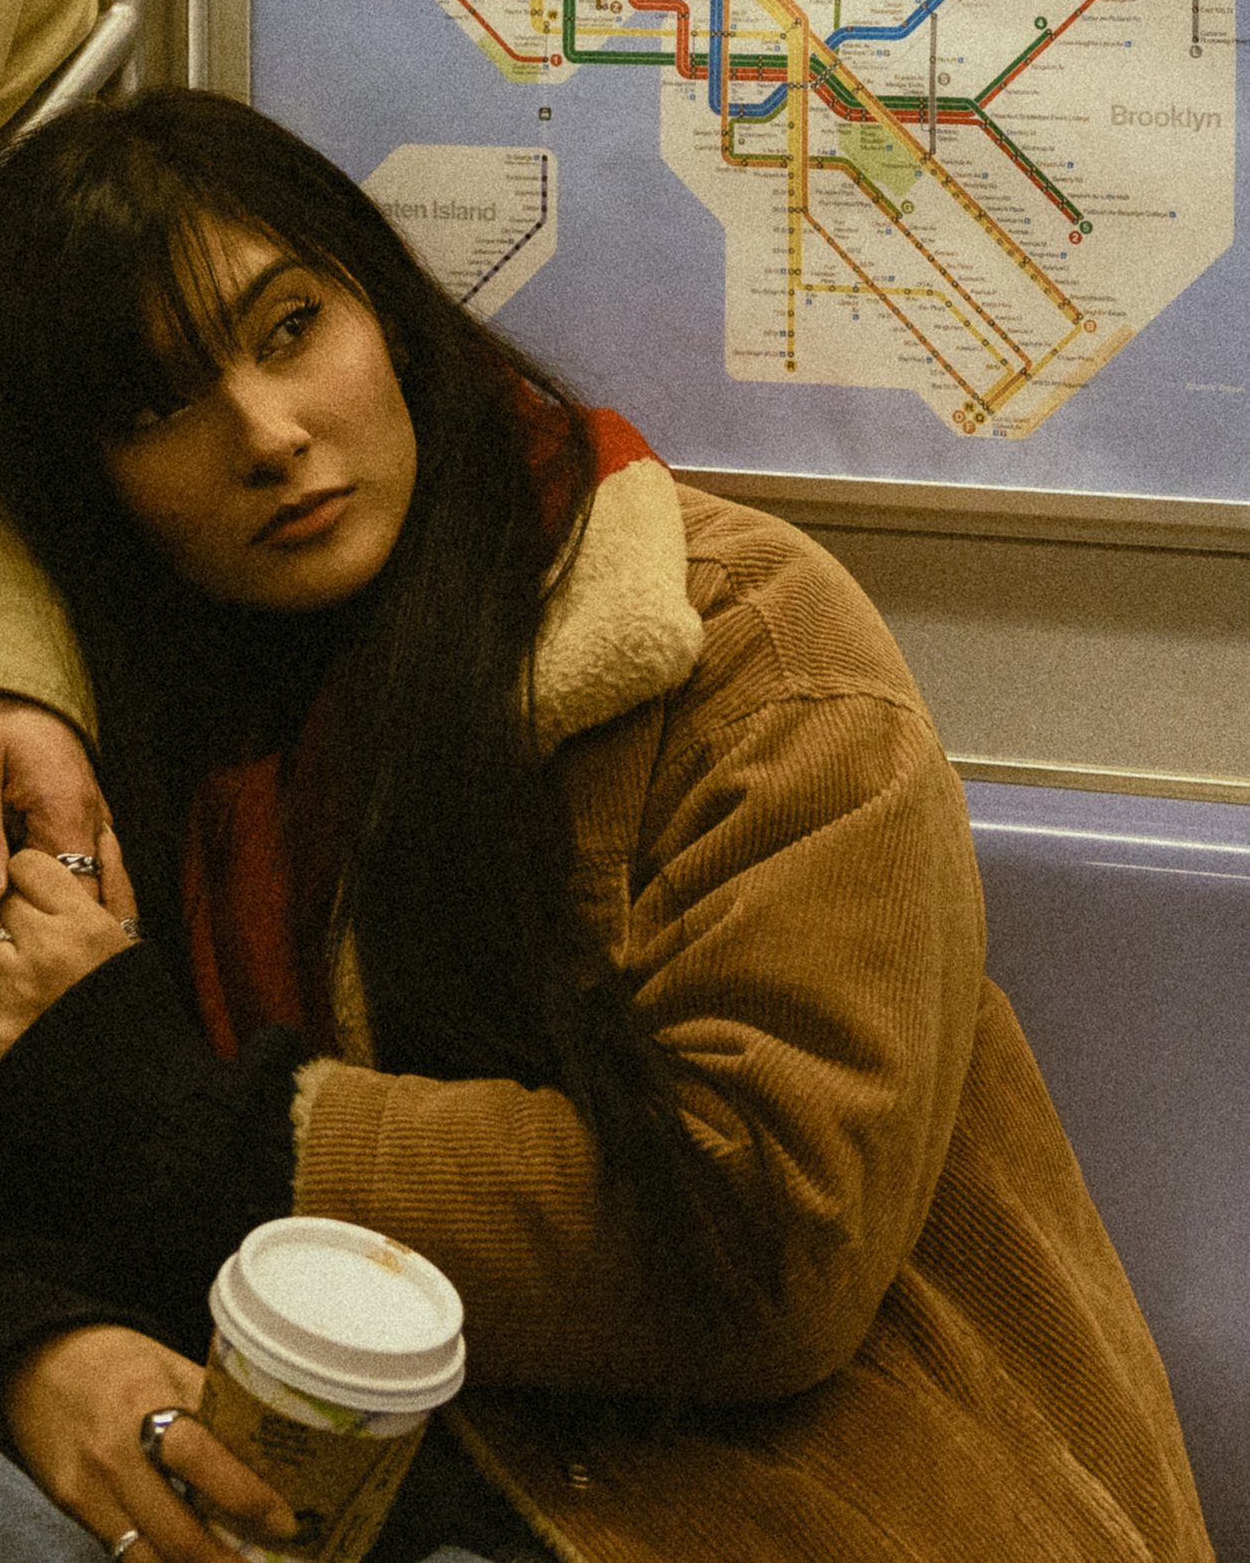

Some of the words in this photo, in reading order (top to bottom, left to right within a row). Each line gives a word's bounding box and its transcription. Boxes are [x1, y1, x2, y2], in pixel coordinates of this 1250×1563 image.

[1111, 104, 1222, 132] Brooklyn
[382, 200, 428, 221] aten
[433, 200, 497, 222] Island
